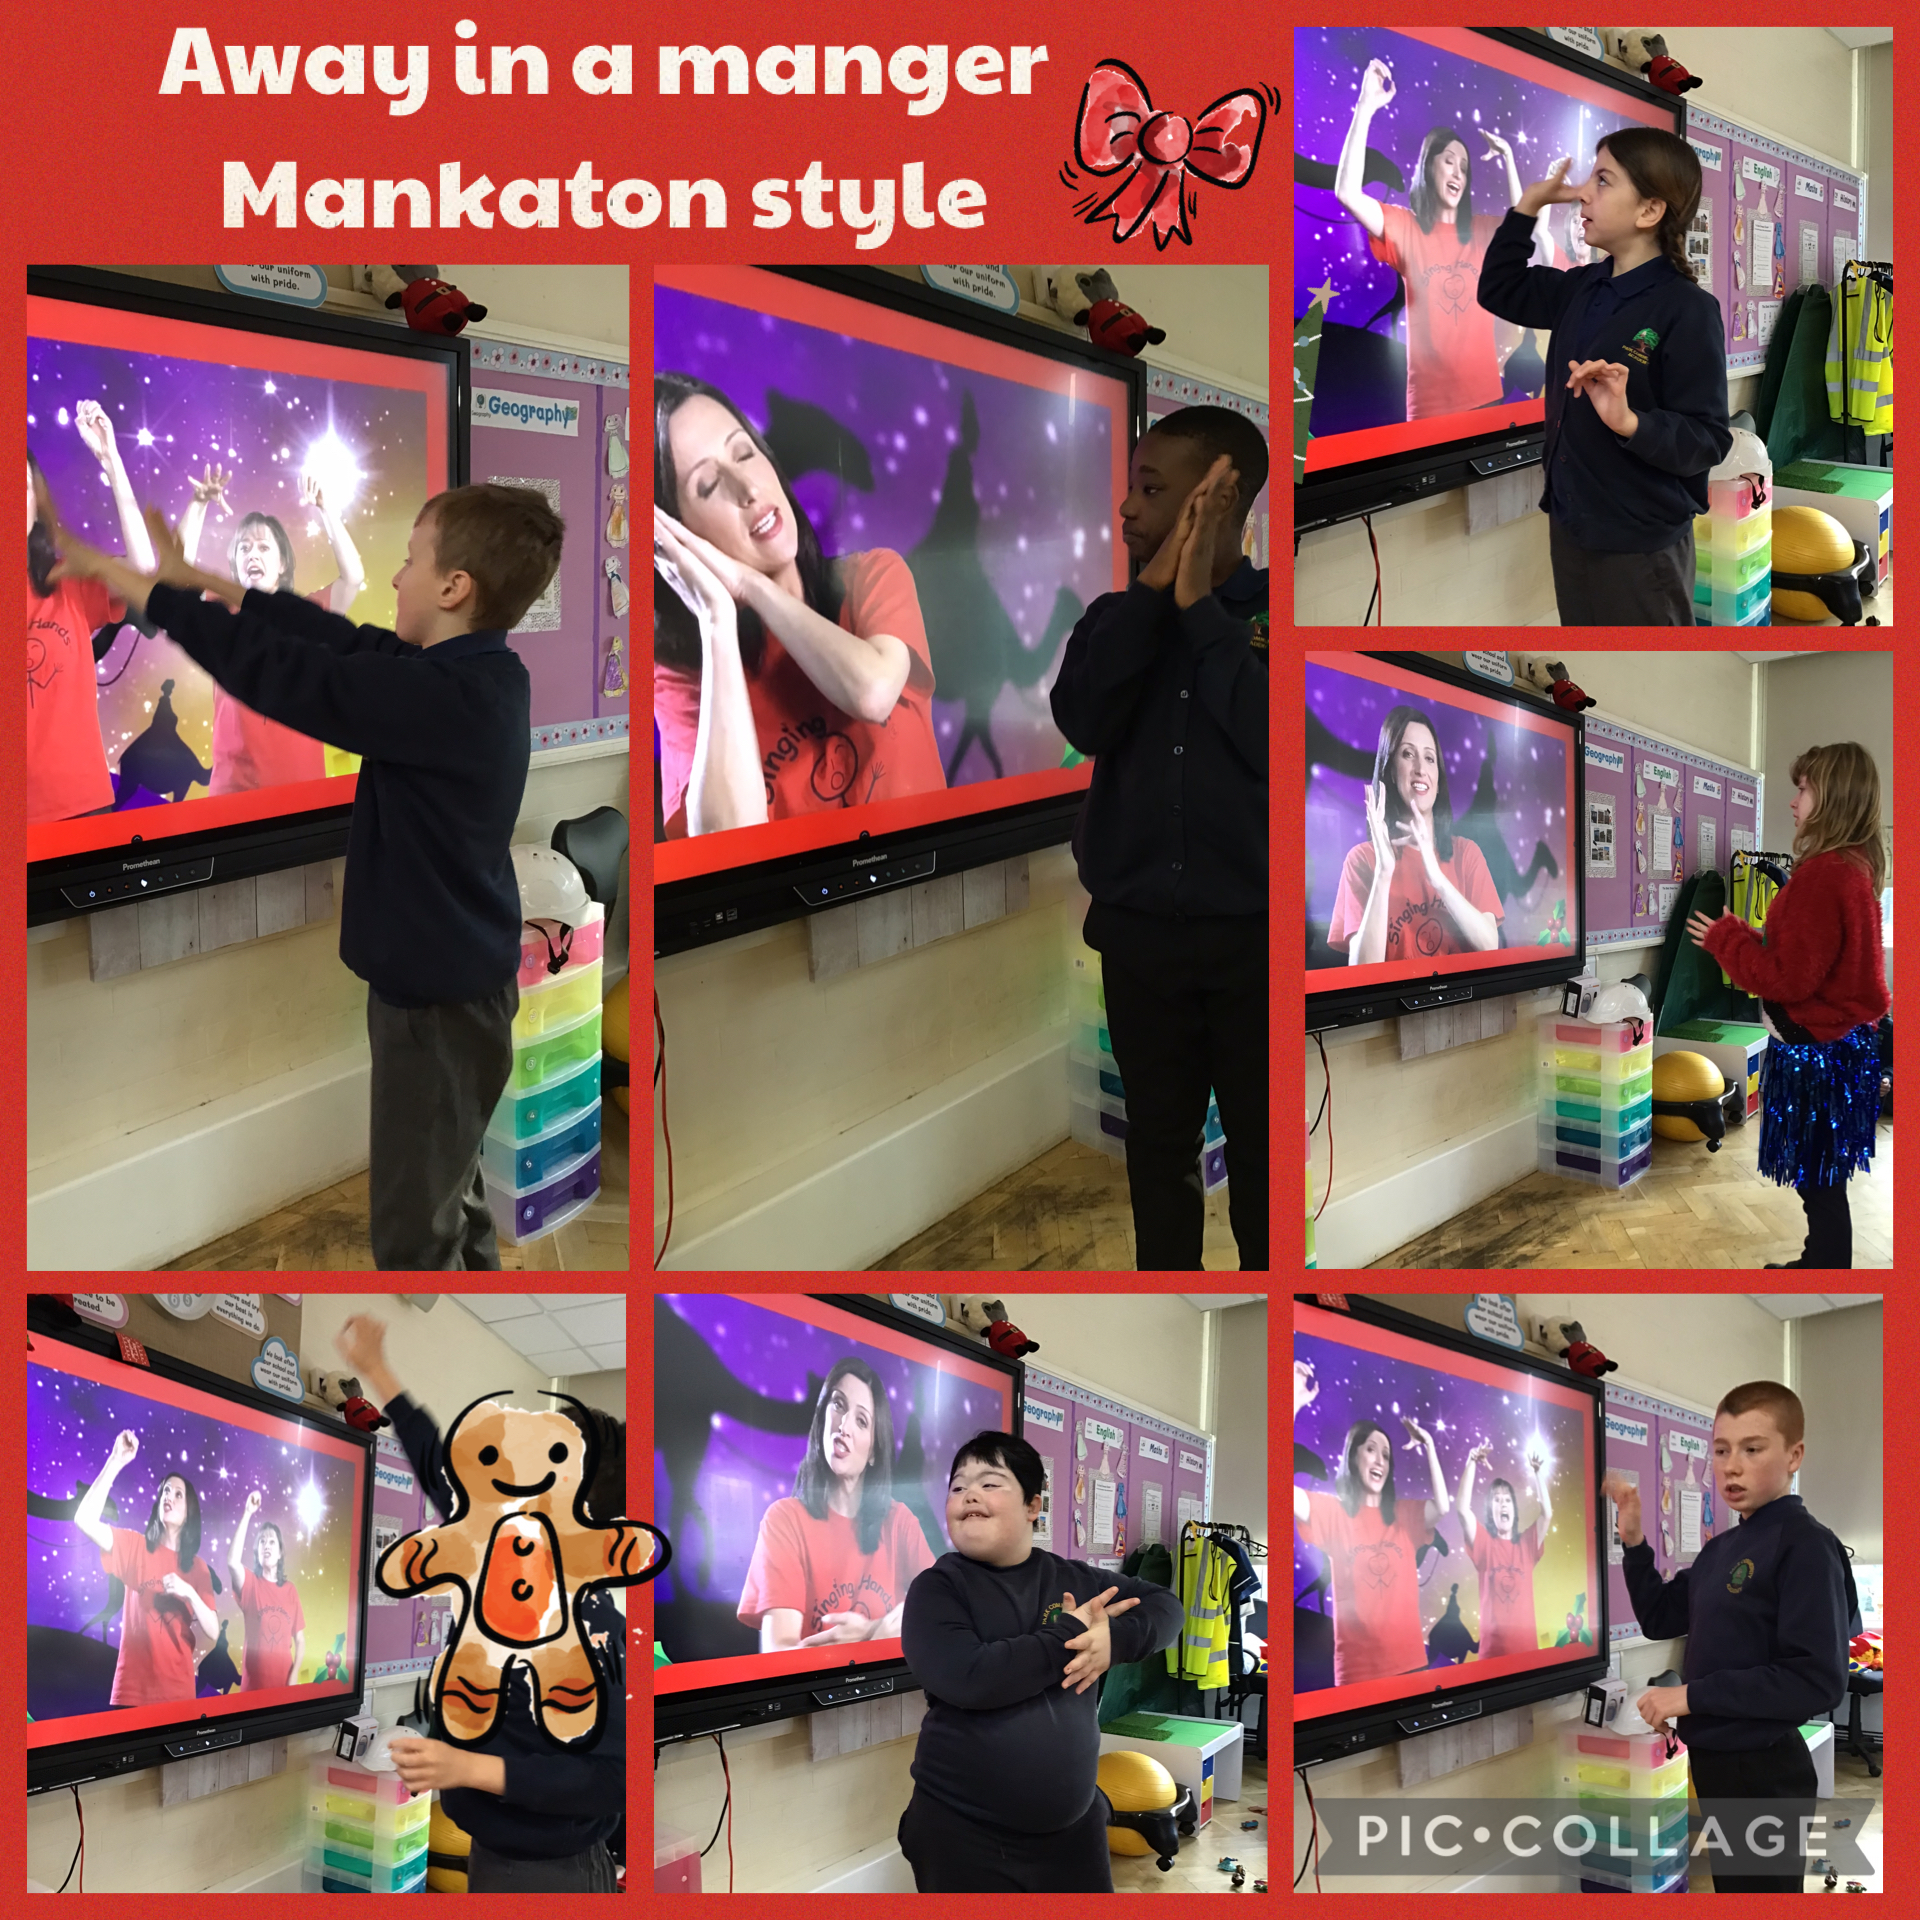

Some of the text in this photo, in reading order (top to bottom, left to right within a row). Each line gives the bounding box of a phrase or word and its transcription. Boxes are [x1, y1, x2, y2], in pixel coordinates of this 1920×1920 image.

[1754, 162, 1773, 180] English
[277, 266, 312, 280] uniform
[960, 265, 974, 277] our
[975, 272, 1006, 289] uniform
[250, 273, 301, 292] with pride.
[952, 277, 997, 299] with pride.
[489, 396, 569, 430] Geography
[28, 617, 71, 647] Hands
[1653, 765, 1672, 780] English
[123, 858, 161, 872] Promethean
[852, 852, 888, 868] Promethean
[1388, 897, 1429, 946] Singing
[95, 1293, 104, 1303] to
[105, 1295, 116, 1308] be
[224, 1299, 235, 1308] our
[1096, 1424, 1116, 1441] English
[1680, 1436, 1700, 1452] English
[811, 1573, 894, 1633] Singing Hands
